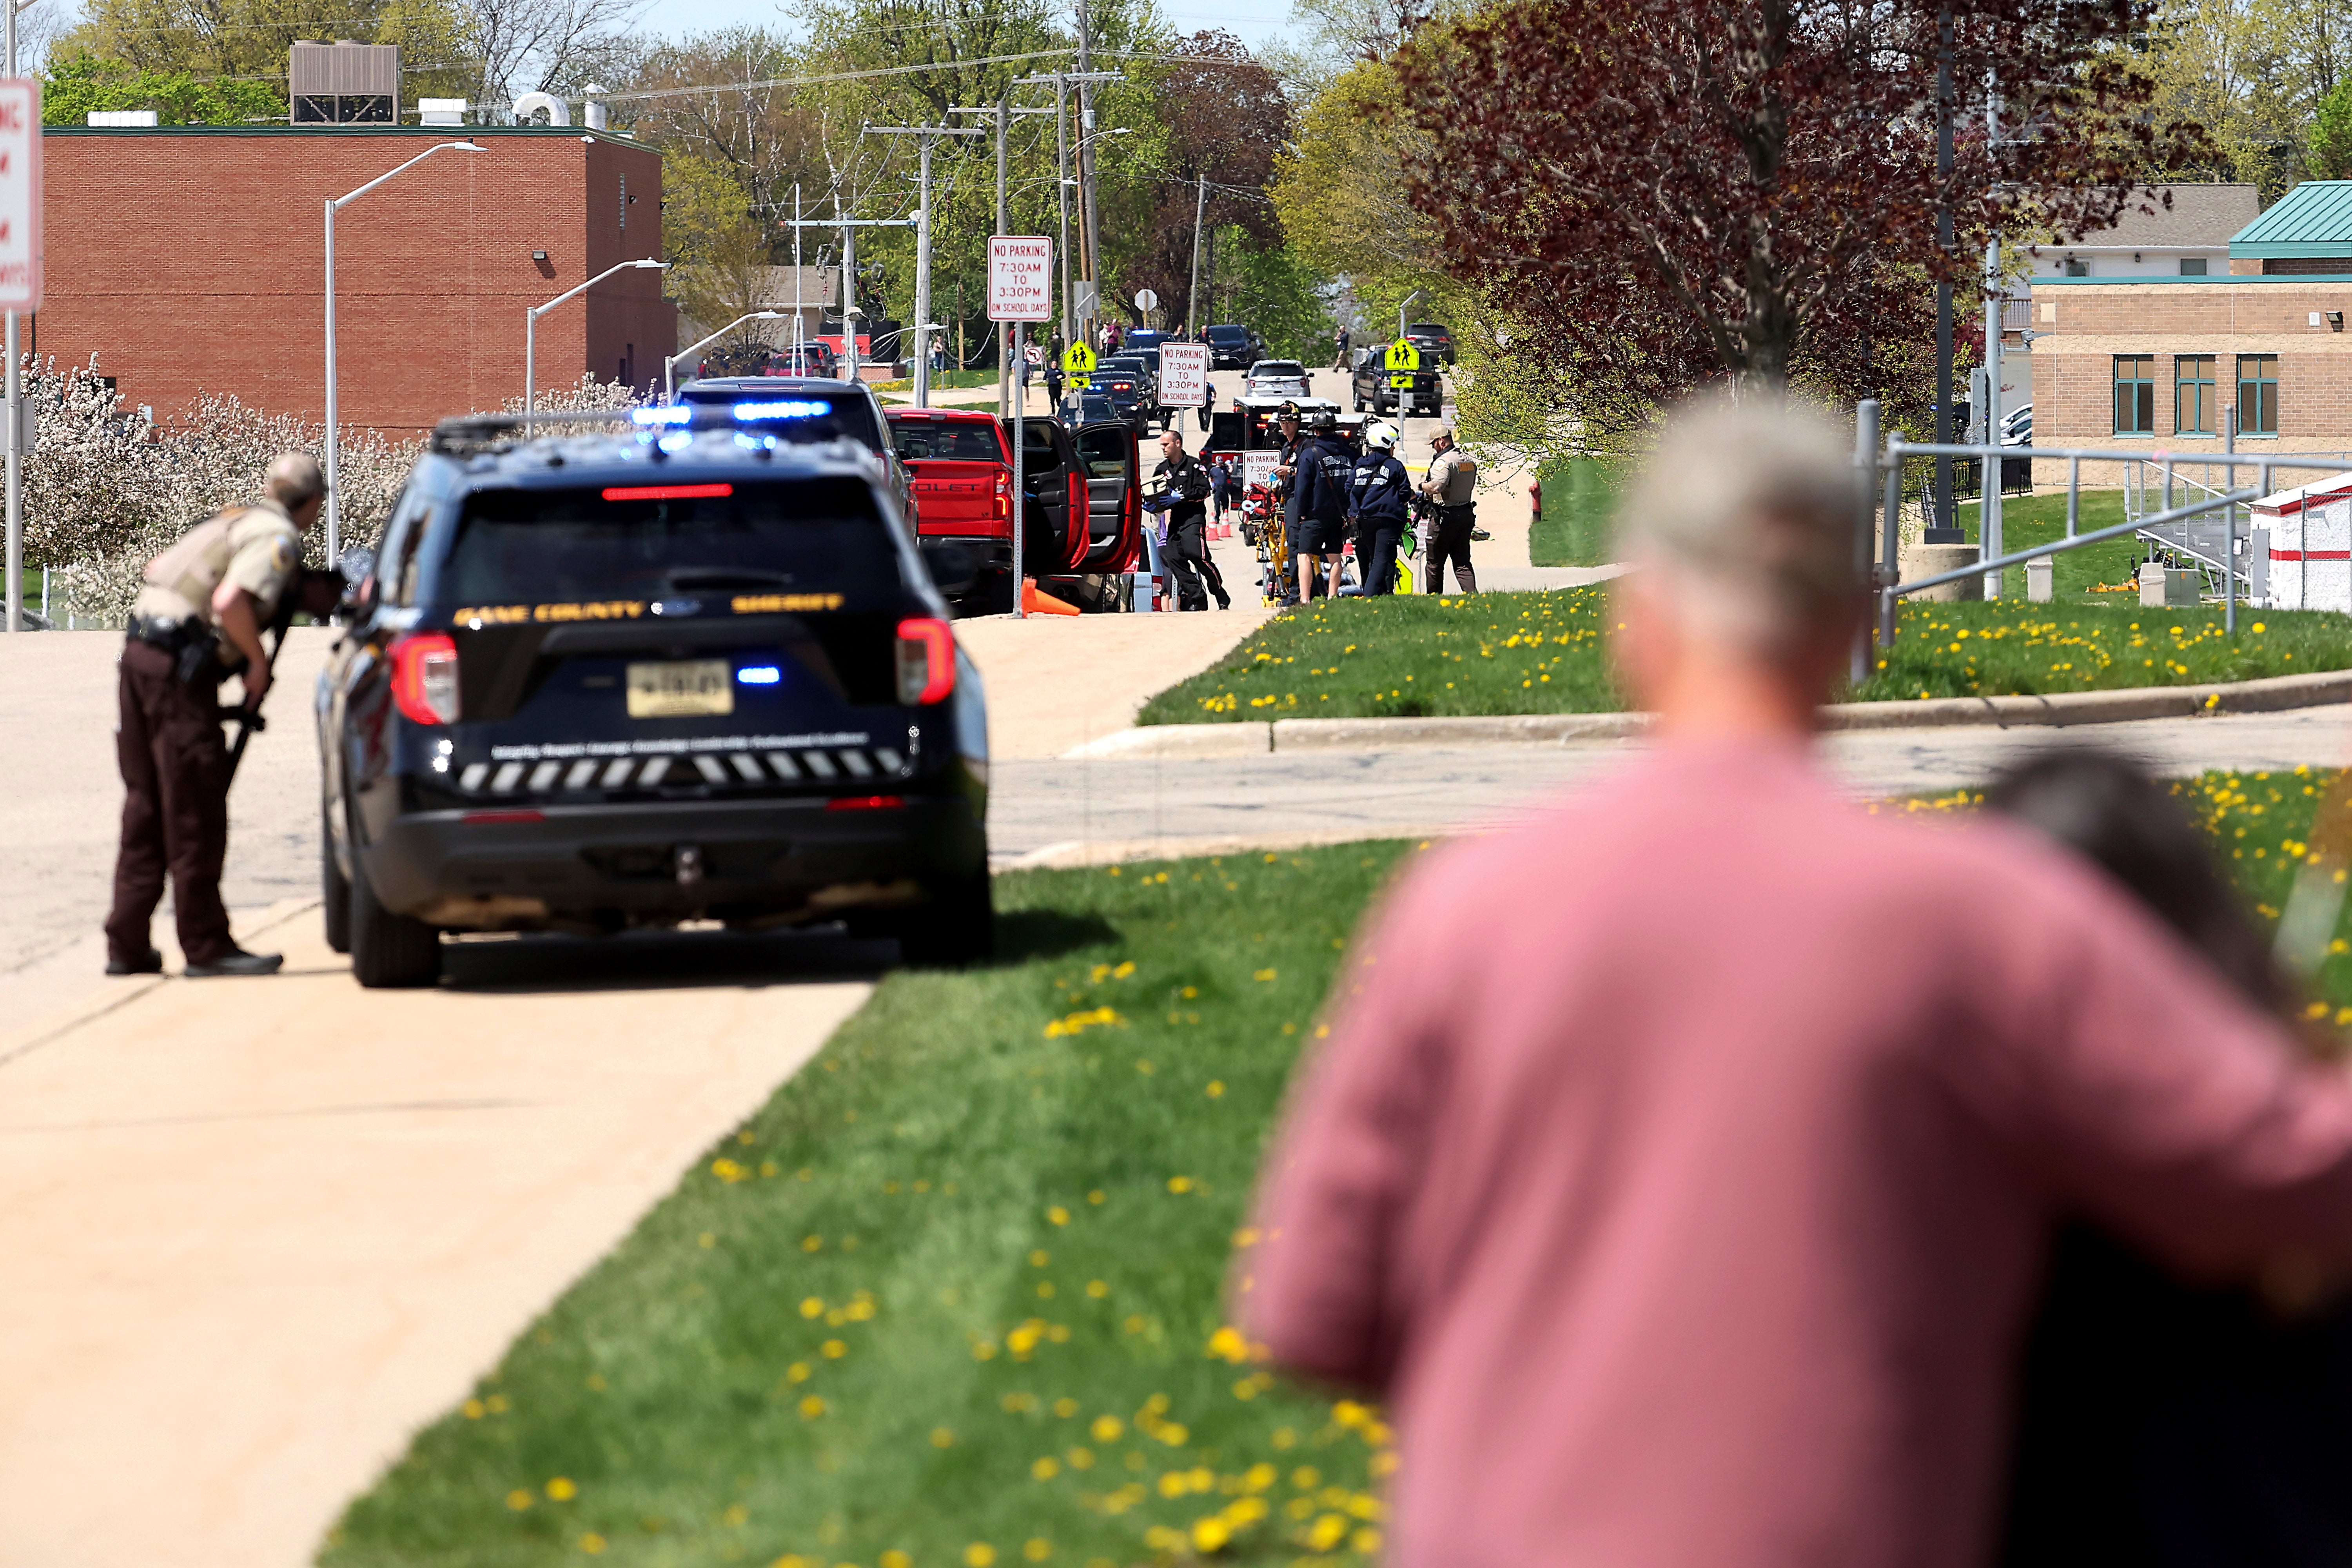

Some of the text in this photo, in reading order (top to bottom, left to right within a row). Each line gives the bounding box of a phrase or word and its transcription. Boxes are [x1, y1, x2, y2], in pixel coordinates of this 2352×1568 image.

[995, 245, 1045, 257] NO PARKING
[1000, 263, 1041, 272] 7:30AM
[1014, 275, 1026, 284] TO
[999, 287, 1040, 297] 3:30PM
[991, 303, 1047, 312] ON SCHOOL DAYS
[1165, 349, 1203, 359] NO PARKING
[1168, 362, 1199, 370] 7:30AM
